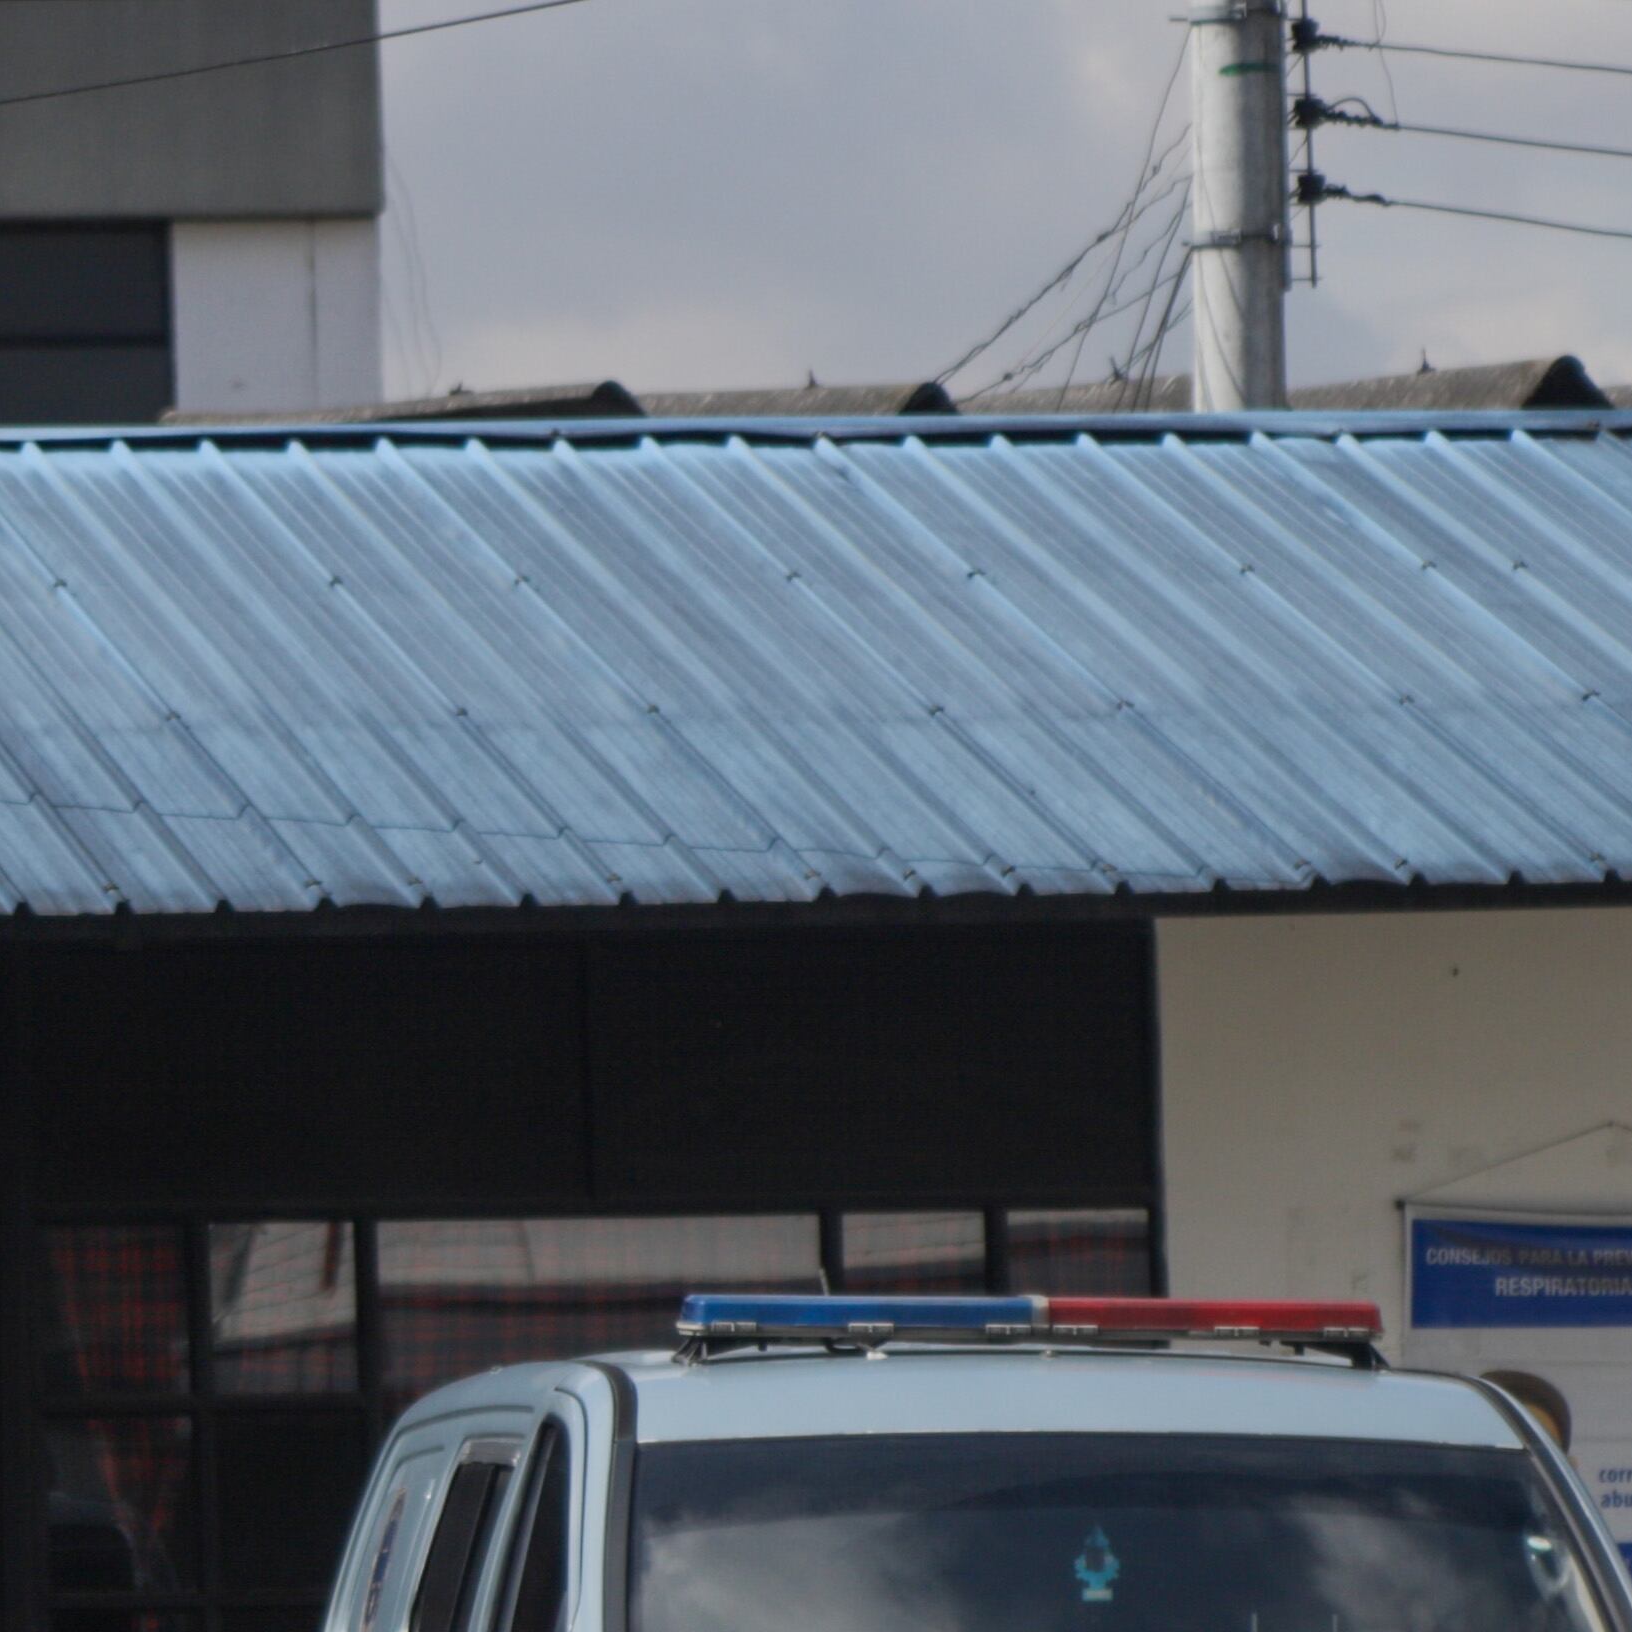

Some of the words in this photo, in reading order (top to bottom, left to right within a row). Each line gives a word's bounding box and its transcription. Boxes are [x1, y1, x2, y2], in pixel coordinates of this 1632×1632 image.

[1425, 1248, 1512, 1266] CONSEJOS
[1518, 1249, 1562, 1266] PARA
[1566, 1249, 1589, 1265] LA
